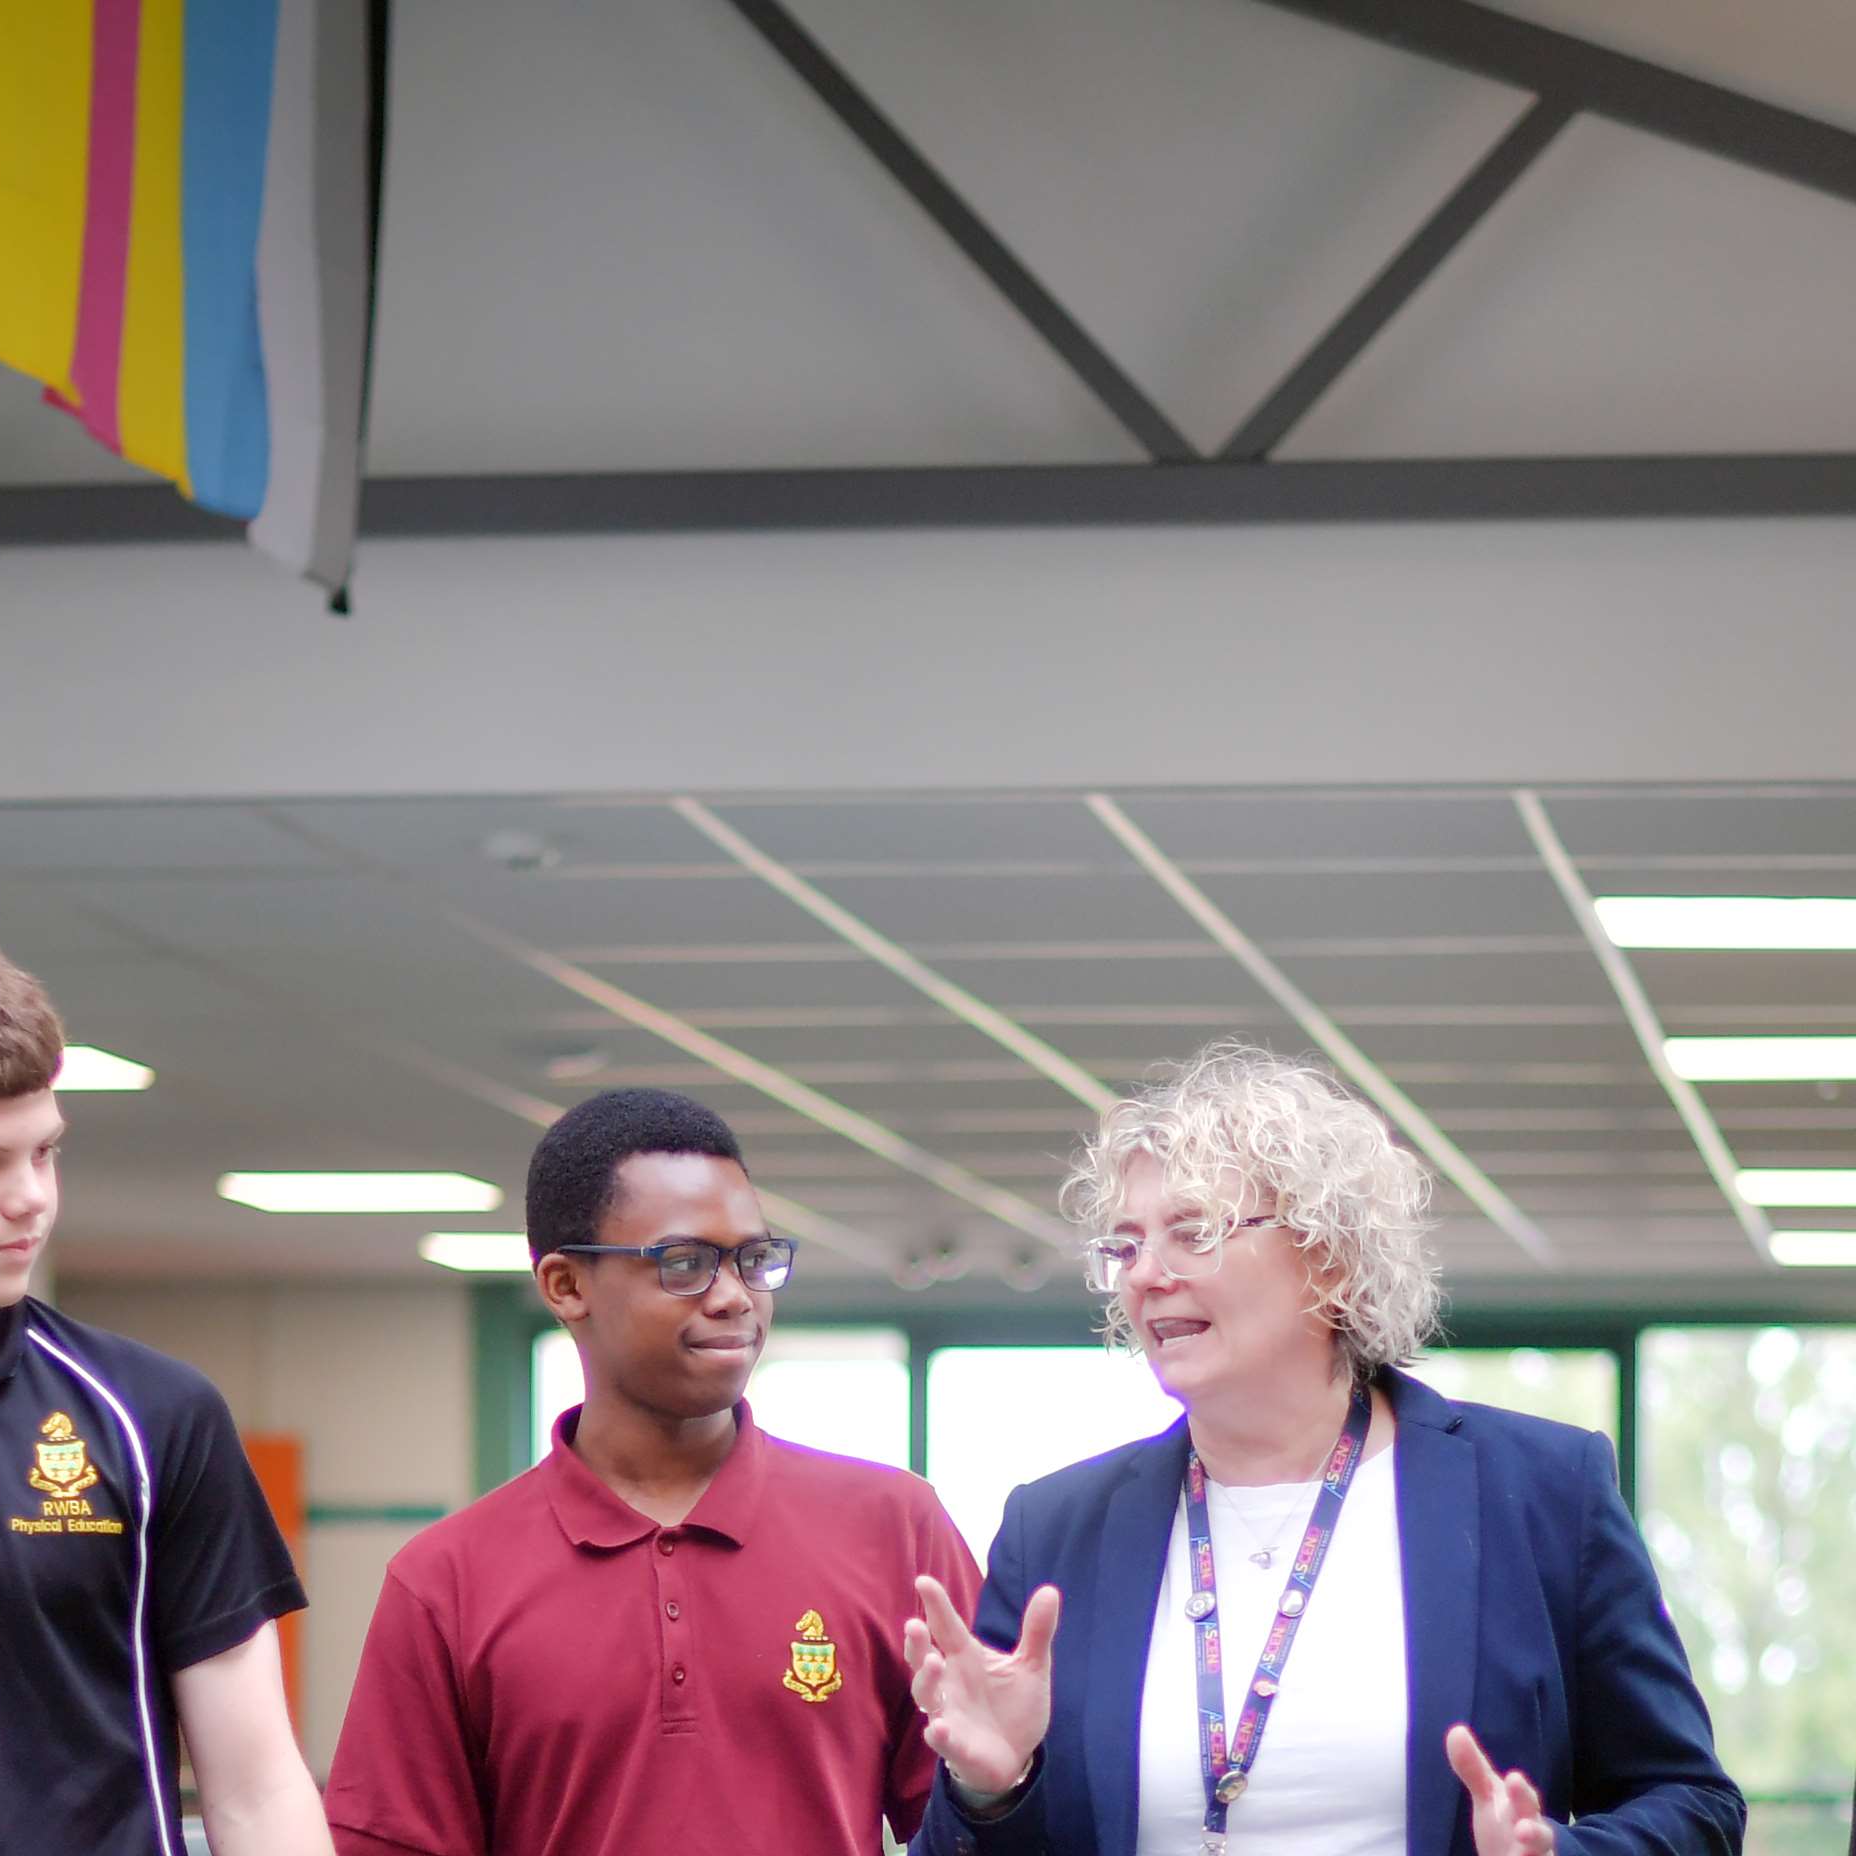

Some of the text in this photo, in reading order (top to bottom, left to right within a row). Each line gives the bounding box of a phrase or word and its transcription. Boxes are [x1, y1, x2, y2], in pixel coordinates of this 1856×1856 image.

[1324, 1433, 1354, 1499] ASCEND
[11, 1519, 123, 1535] Physical Education
[42, 1500, 92, 1516] RWBA
[1292, 1527, 1322, 1589] ASCEND
